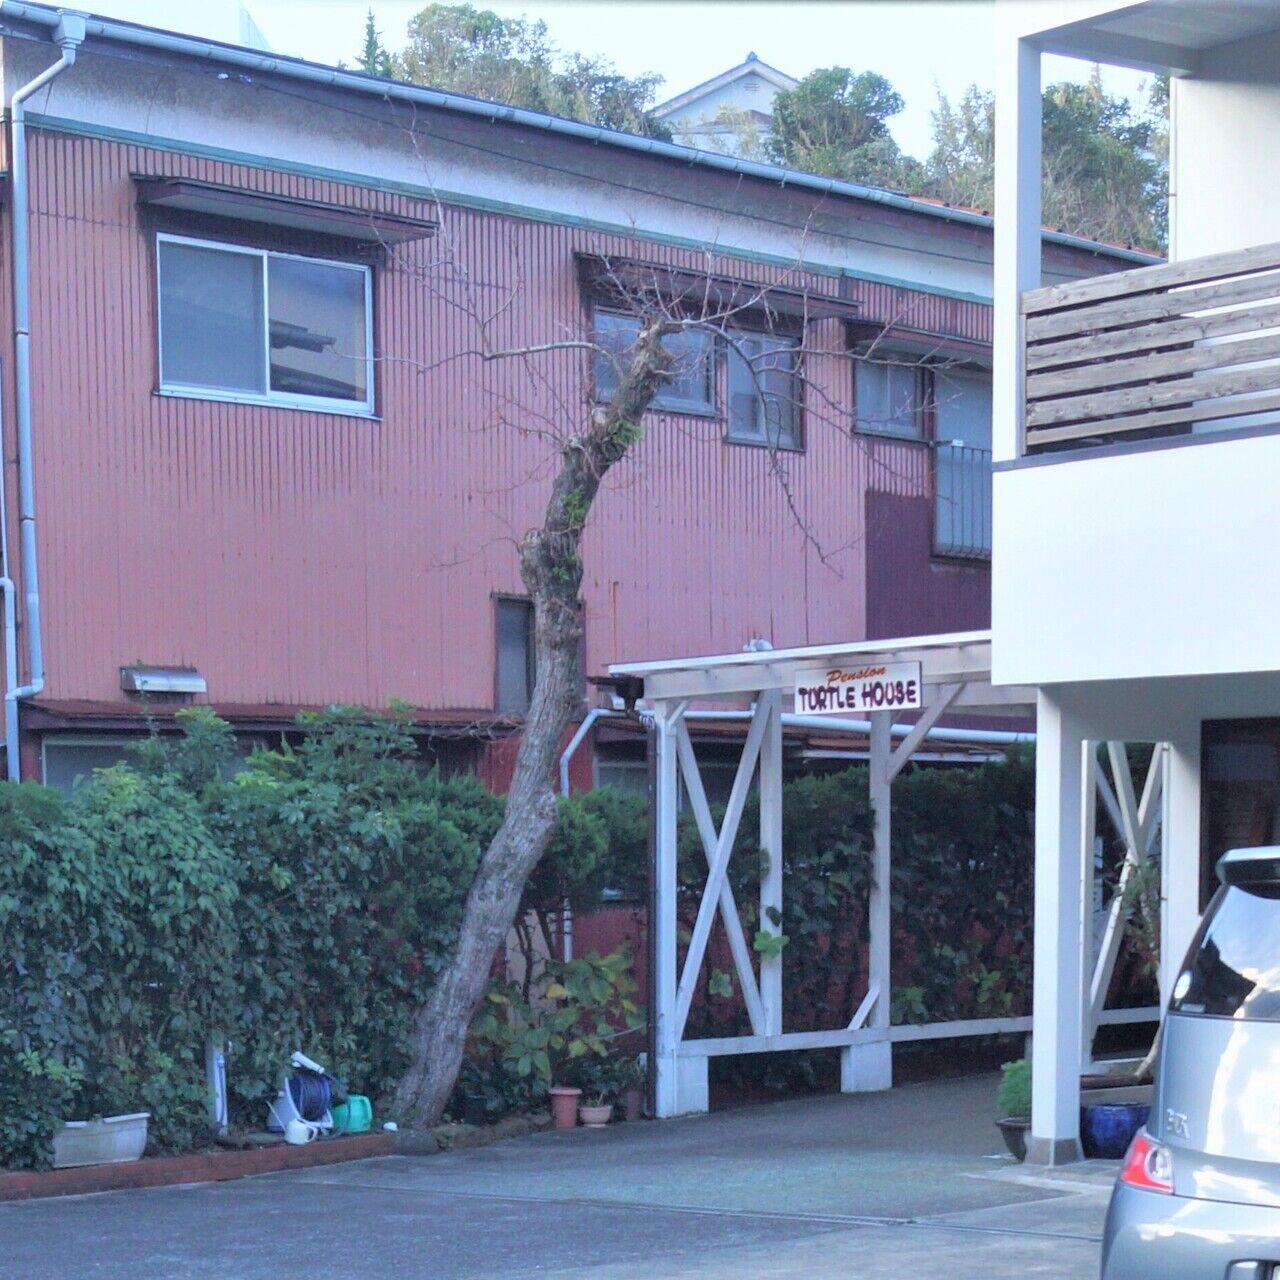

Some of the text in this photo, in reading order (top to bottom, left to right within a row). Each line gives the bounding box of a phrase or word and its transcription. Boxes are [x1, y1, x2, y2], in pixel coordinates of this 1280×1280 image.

[825, 665, 888, 686] Pension
[798, 679, 917, 712] TURTLE HOUSE
